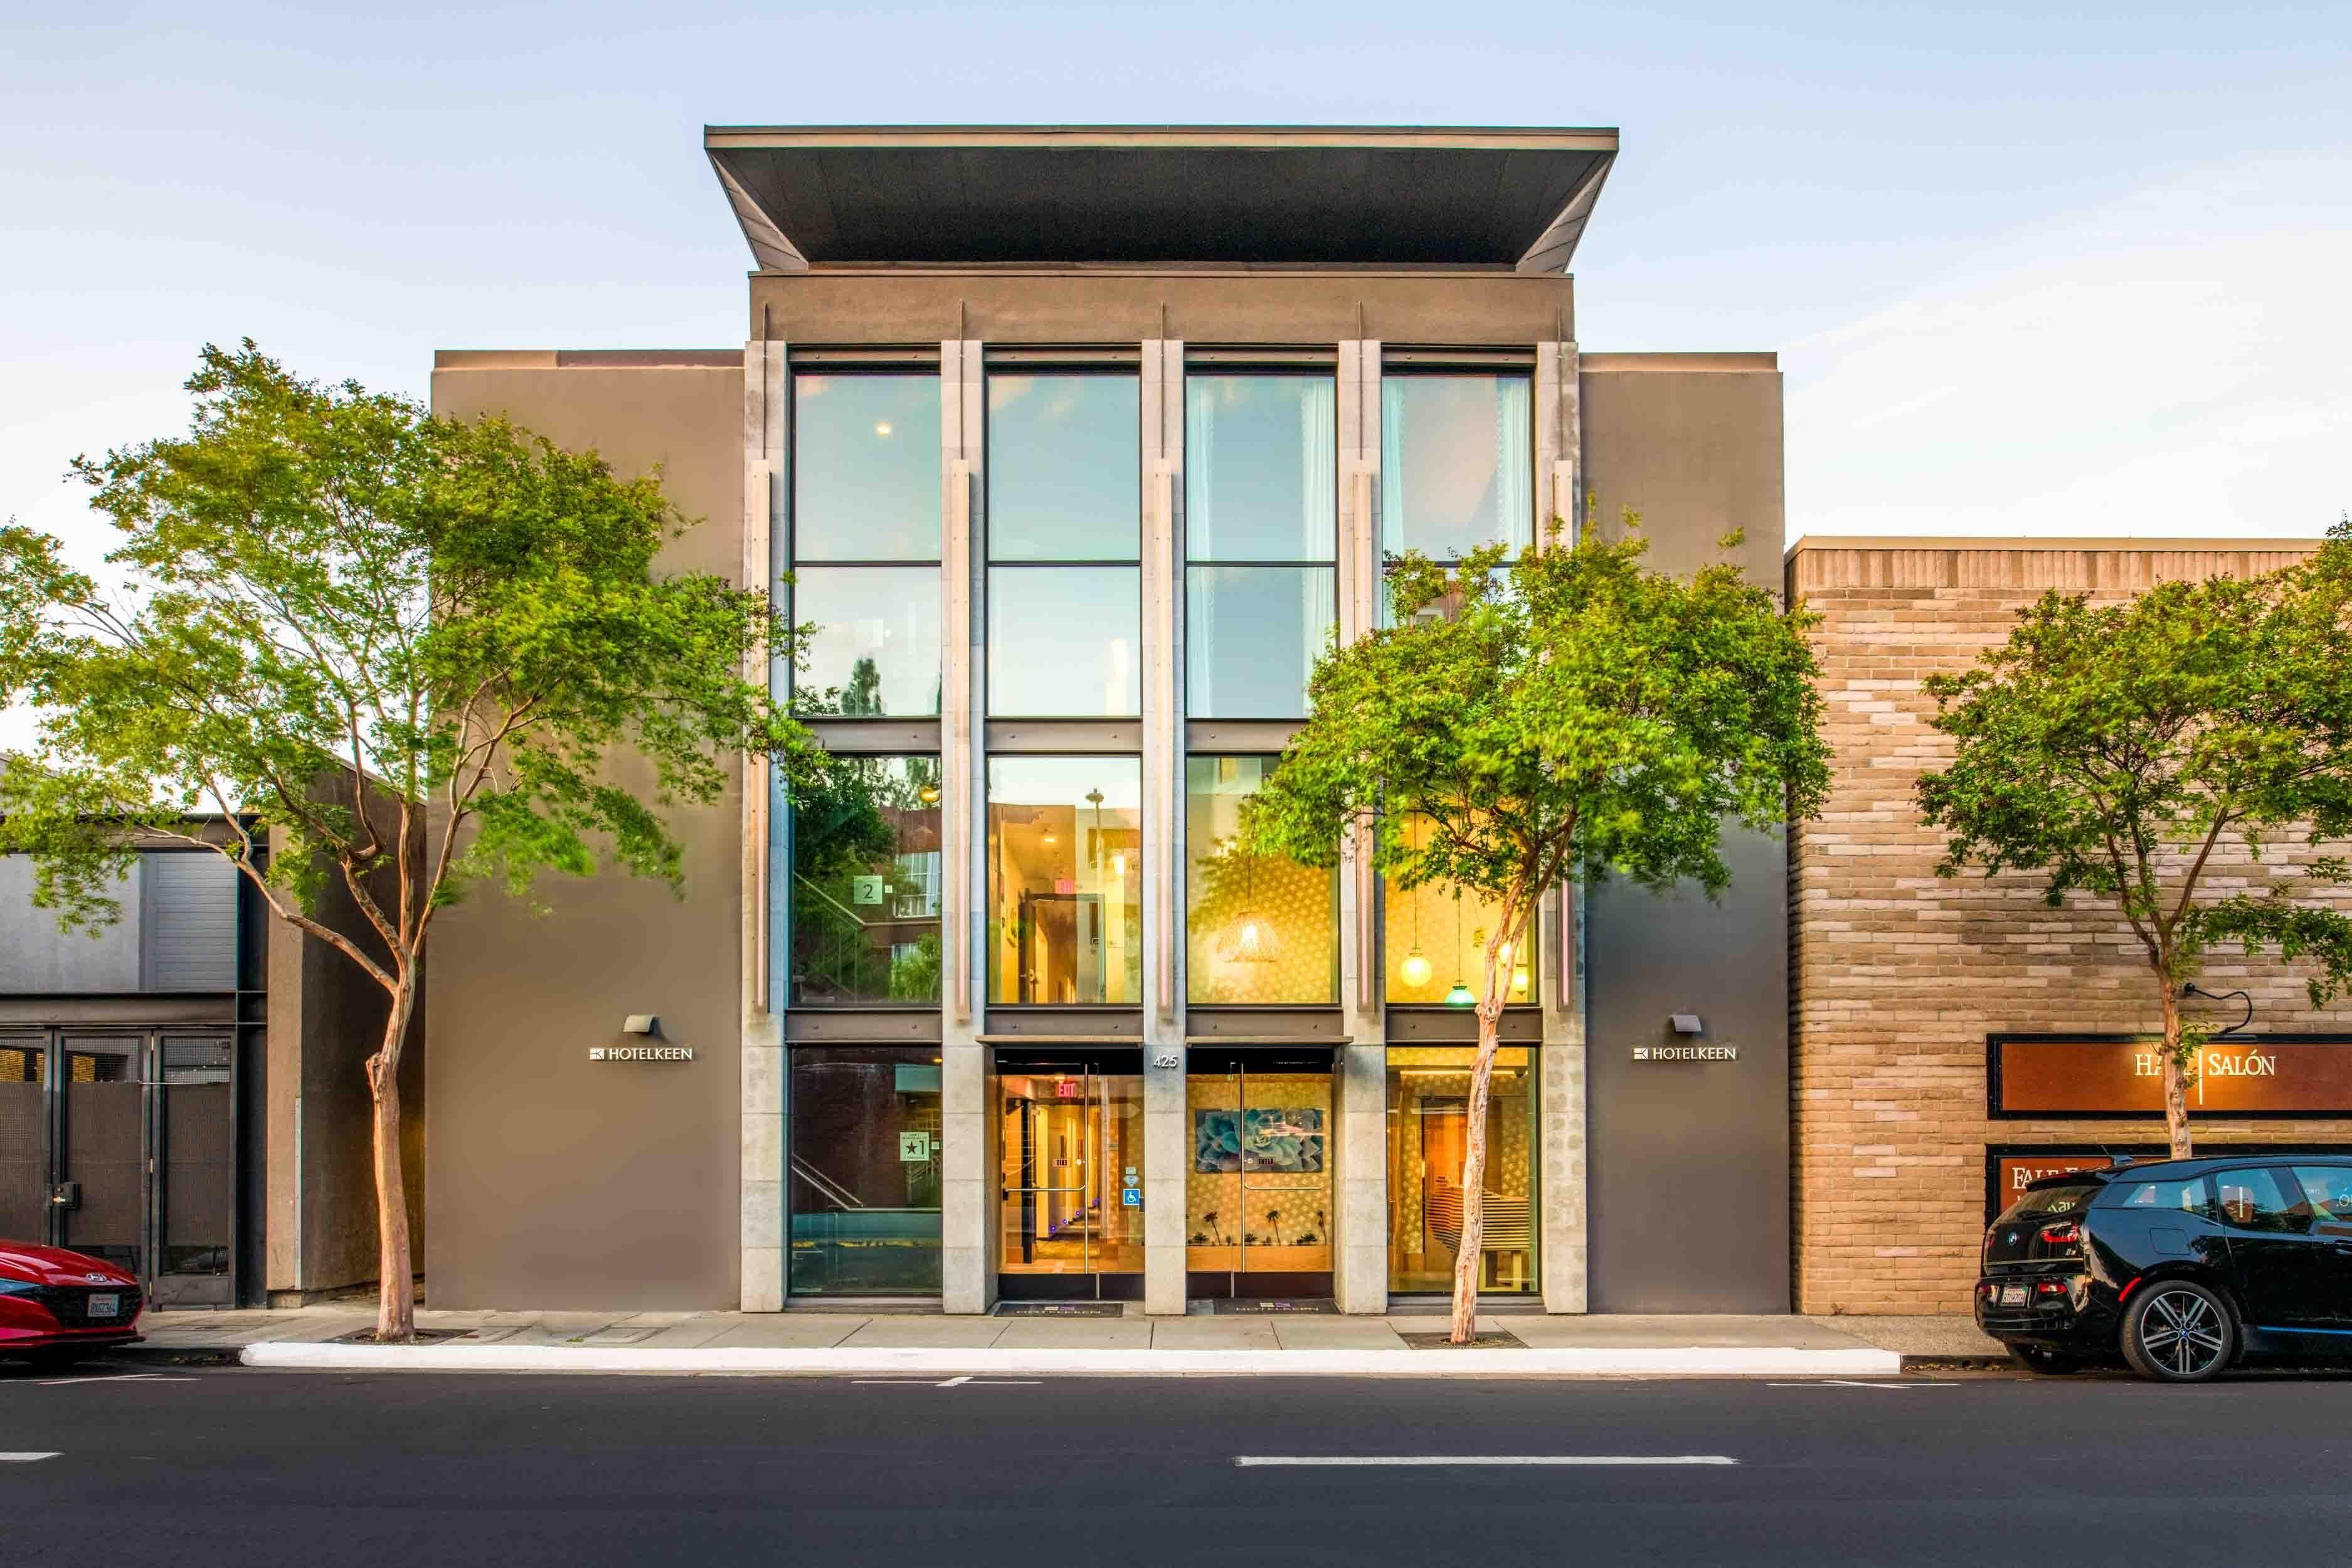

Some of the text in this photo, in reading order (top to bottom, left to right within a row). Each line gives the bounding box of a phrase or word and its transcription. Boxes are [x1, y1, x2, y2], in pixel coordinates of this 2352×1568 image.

[863, 884, 873, 899] 2
[609, 1048, 692, 1059] HOTELKEEN
[1653, 1048, 1736, 1059] HOTELKEEN
[1153, 1055, 1179, 1067] 425
[2208, 1049, 2276, 1076] SALÓN
[1058, 1083, 1074, 1098] EXIT
